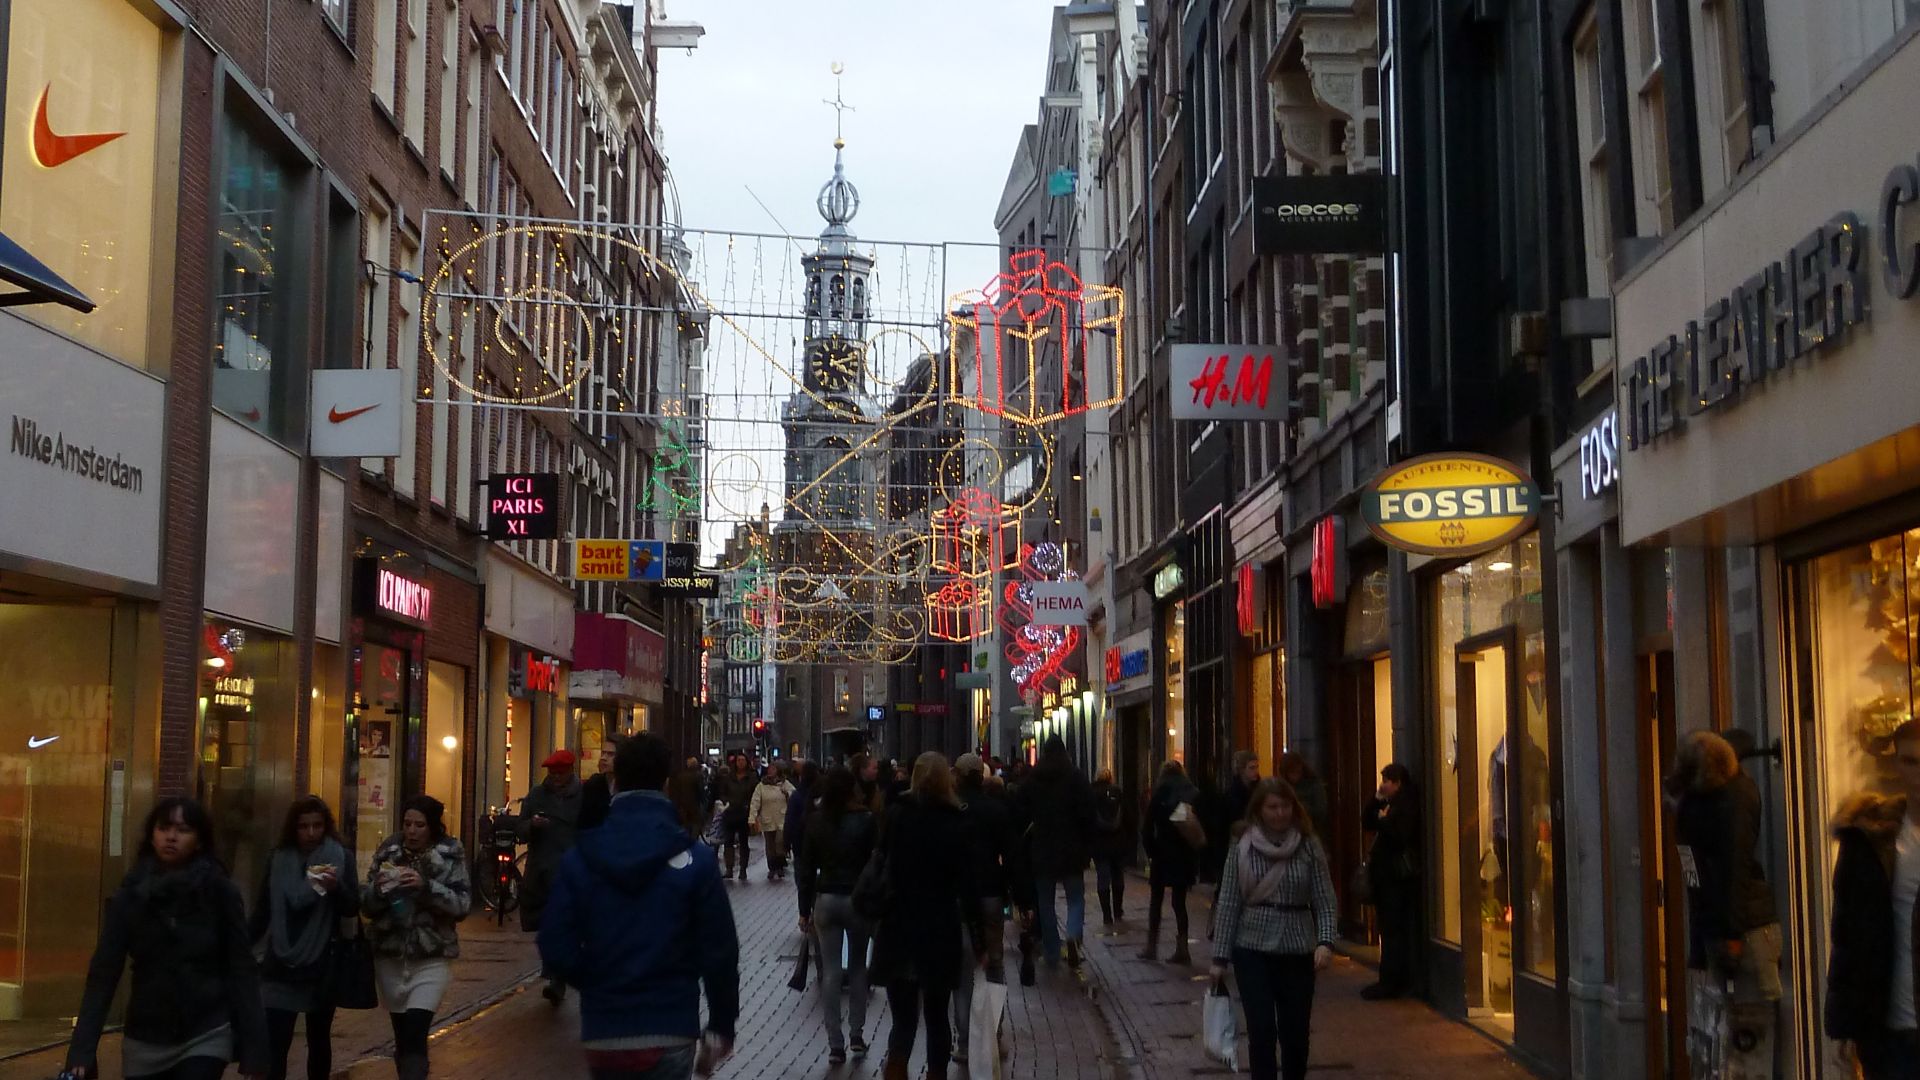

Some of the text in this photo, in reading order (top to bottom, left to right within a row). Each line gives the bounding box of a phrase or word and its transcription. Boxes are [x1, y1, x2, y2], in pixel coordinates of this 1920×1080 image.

[1619, 152, 1920, 451] THE LEATHER C
[1188, 352, 1274, 411] H&M
[1393, 462, 1510, 488] AUTHENTIC
[506, 478, 532, 493] ICI
[492, 498, 544, 514] PARIS
[507, 519, 529, 535] XL
[581, 545, 624, 559] bart
[580, 560, 625, 575] smit
[1036, 596, 1084, 610] HEMA
